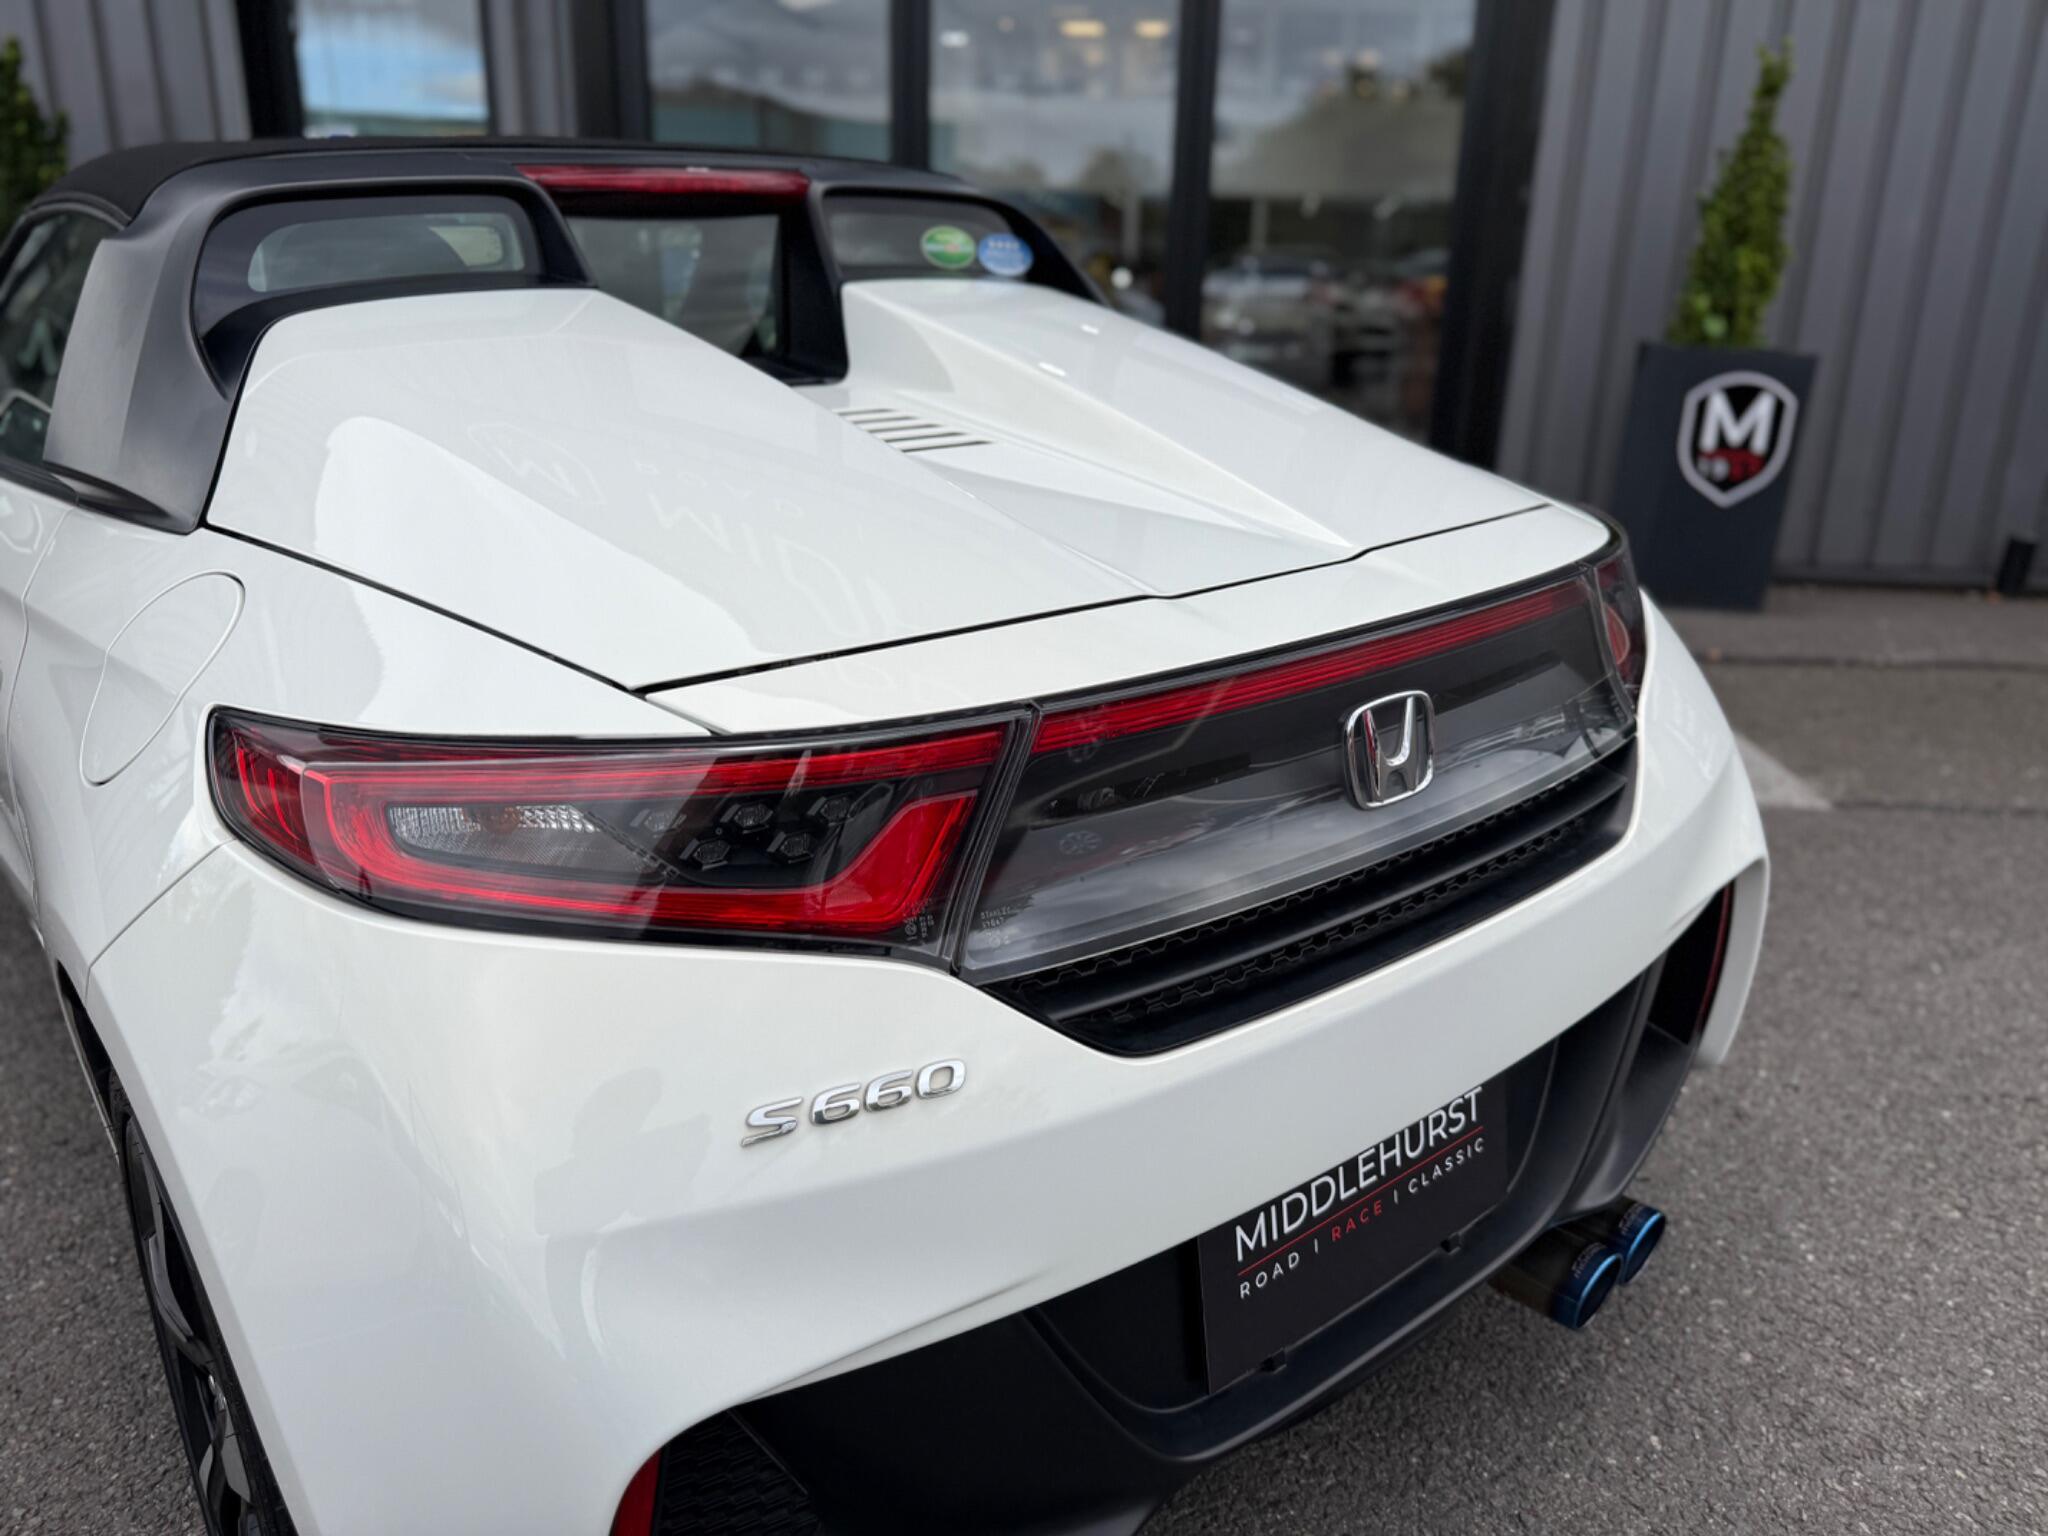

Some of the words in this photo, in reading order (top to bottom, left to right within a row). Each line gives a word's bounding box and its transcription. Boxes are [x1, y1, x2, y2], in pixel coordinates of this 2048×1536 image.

[1699, 389, 1777, 456] M
[740, 1058, 967, 1148] S660
[1235, 1086, 1482, 1263] MIDDLEHURST
[1239, 1252, 1299, 1299] ROAD
[1330, 1200, 1384, 1242] RACE
[1408, 1137, 1485, 1194] CLASSIC
